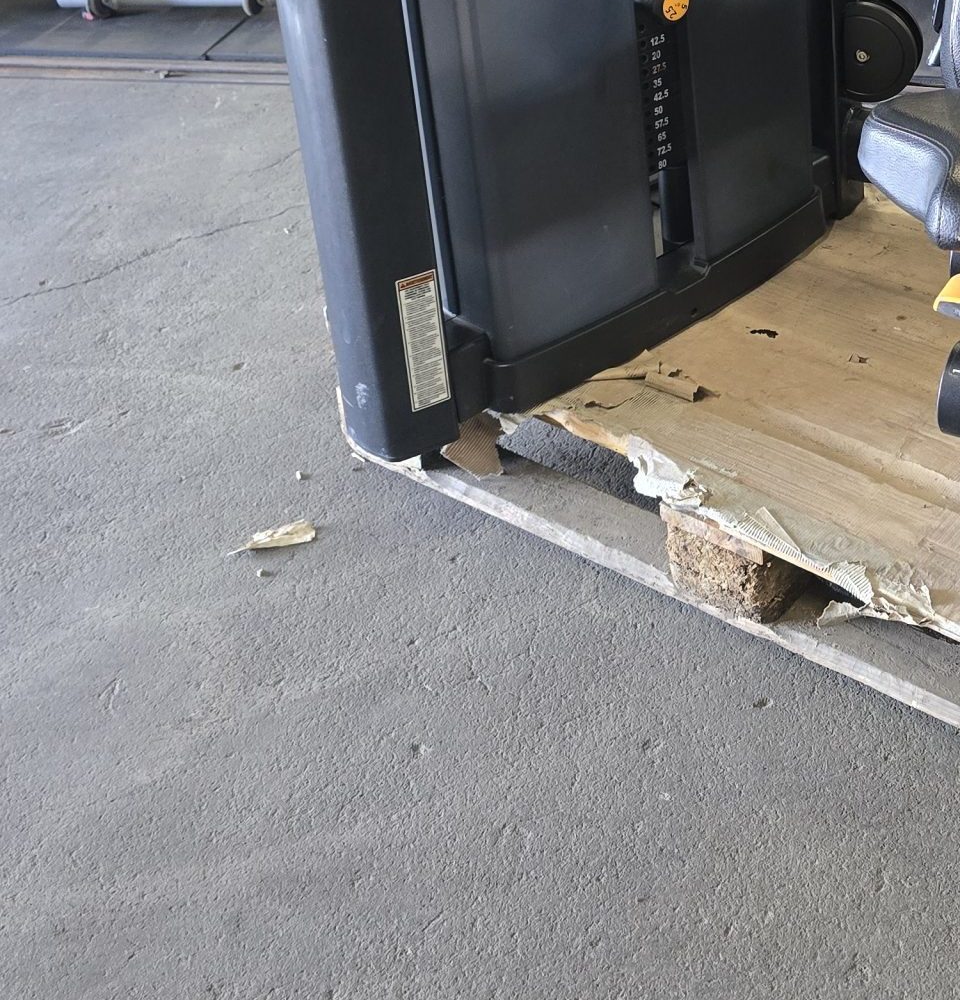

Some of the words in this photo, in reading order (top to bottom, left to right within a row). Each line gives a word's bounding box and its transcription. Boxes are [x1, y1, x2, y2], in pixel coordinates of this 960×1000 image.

[650, 33, 666, 47] 12.5
[651, 49, 661, 61] 20
[653, 77, 663, 89] 35
[653, 88, 669, 101] 42.5
[654, 105, 663, 116] 50
[654, 116, 669, 130] 57.5
[657, 131, 667, 142] 65
[657, 143, 672, 157] 72.5
[658, 158, 667, 170] 80
